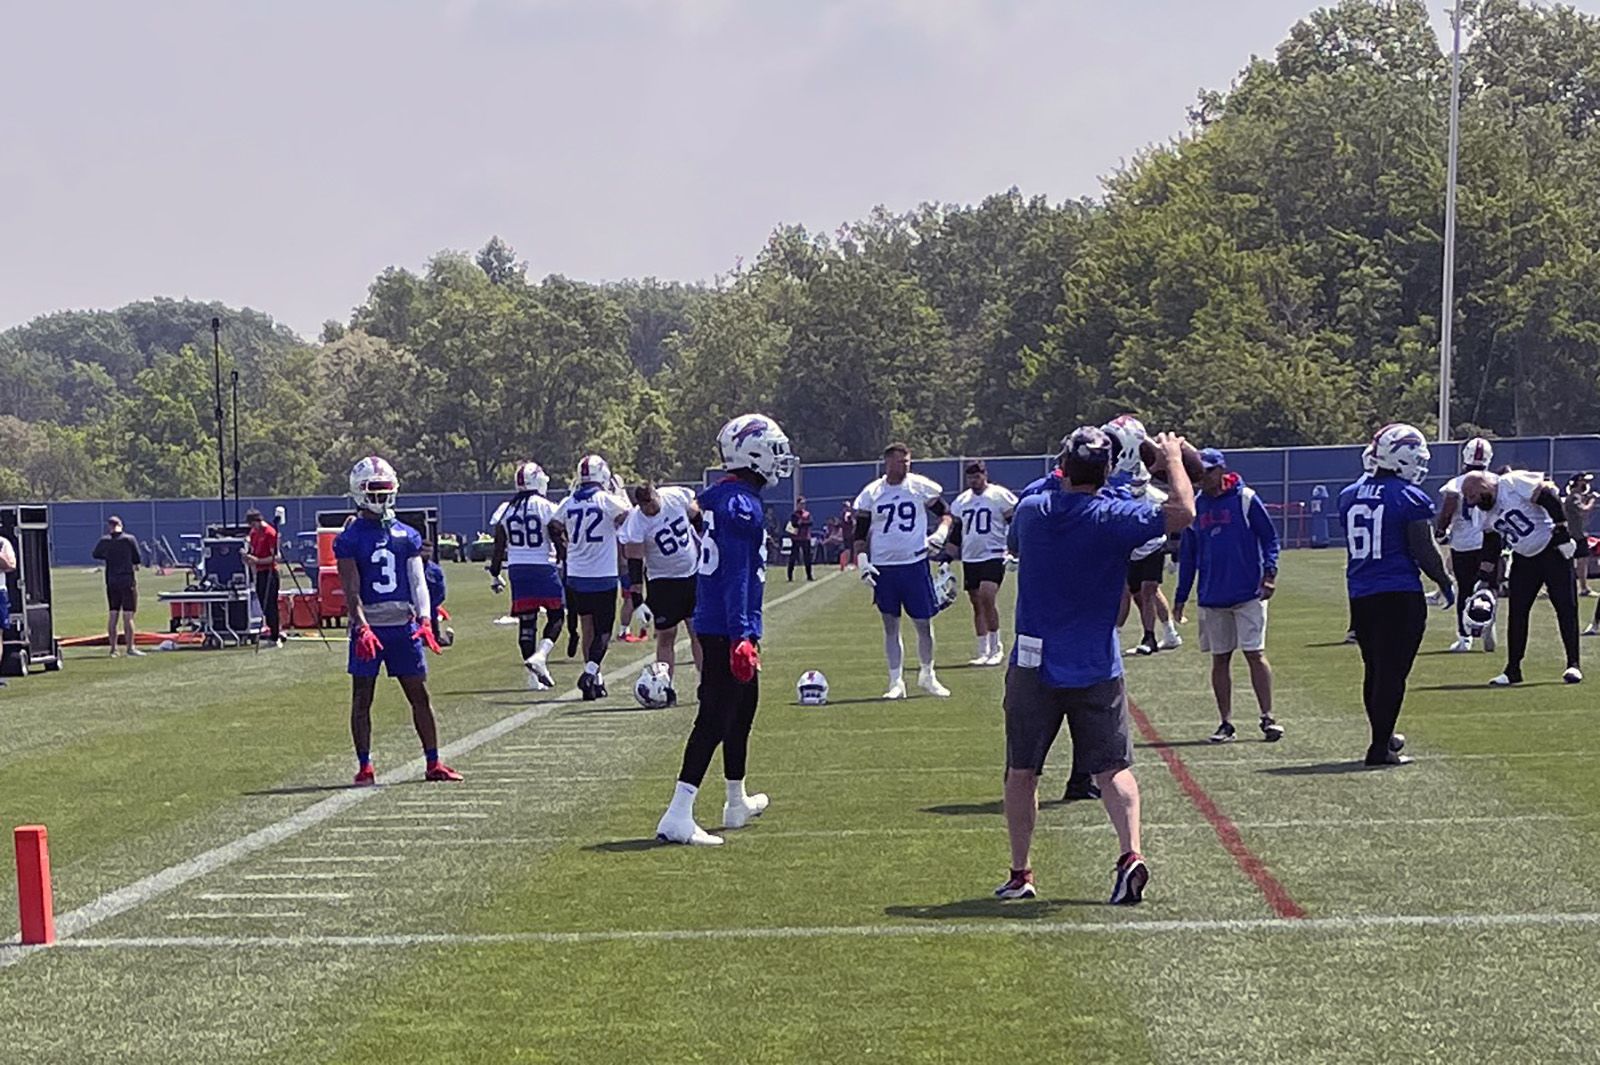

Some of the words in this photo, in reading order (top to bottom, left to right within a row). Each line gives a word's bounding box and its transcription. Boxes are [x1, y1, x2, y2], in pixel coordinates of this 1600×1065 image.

[506, 514, 543, 548] 68
[567, 507, 603, 544] 72
[654, 515, 689, 556] 65
[877, 501, 916, 534] 79
[962, 508, 992, 535] 70
[1347, 504, 1385, 560] 61
[371, 549, 397, 594] 3
